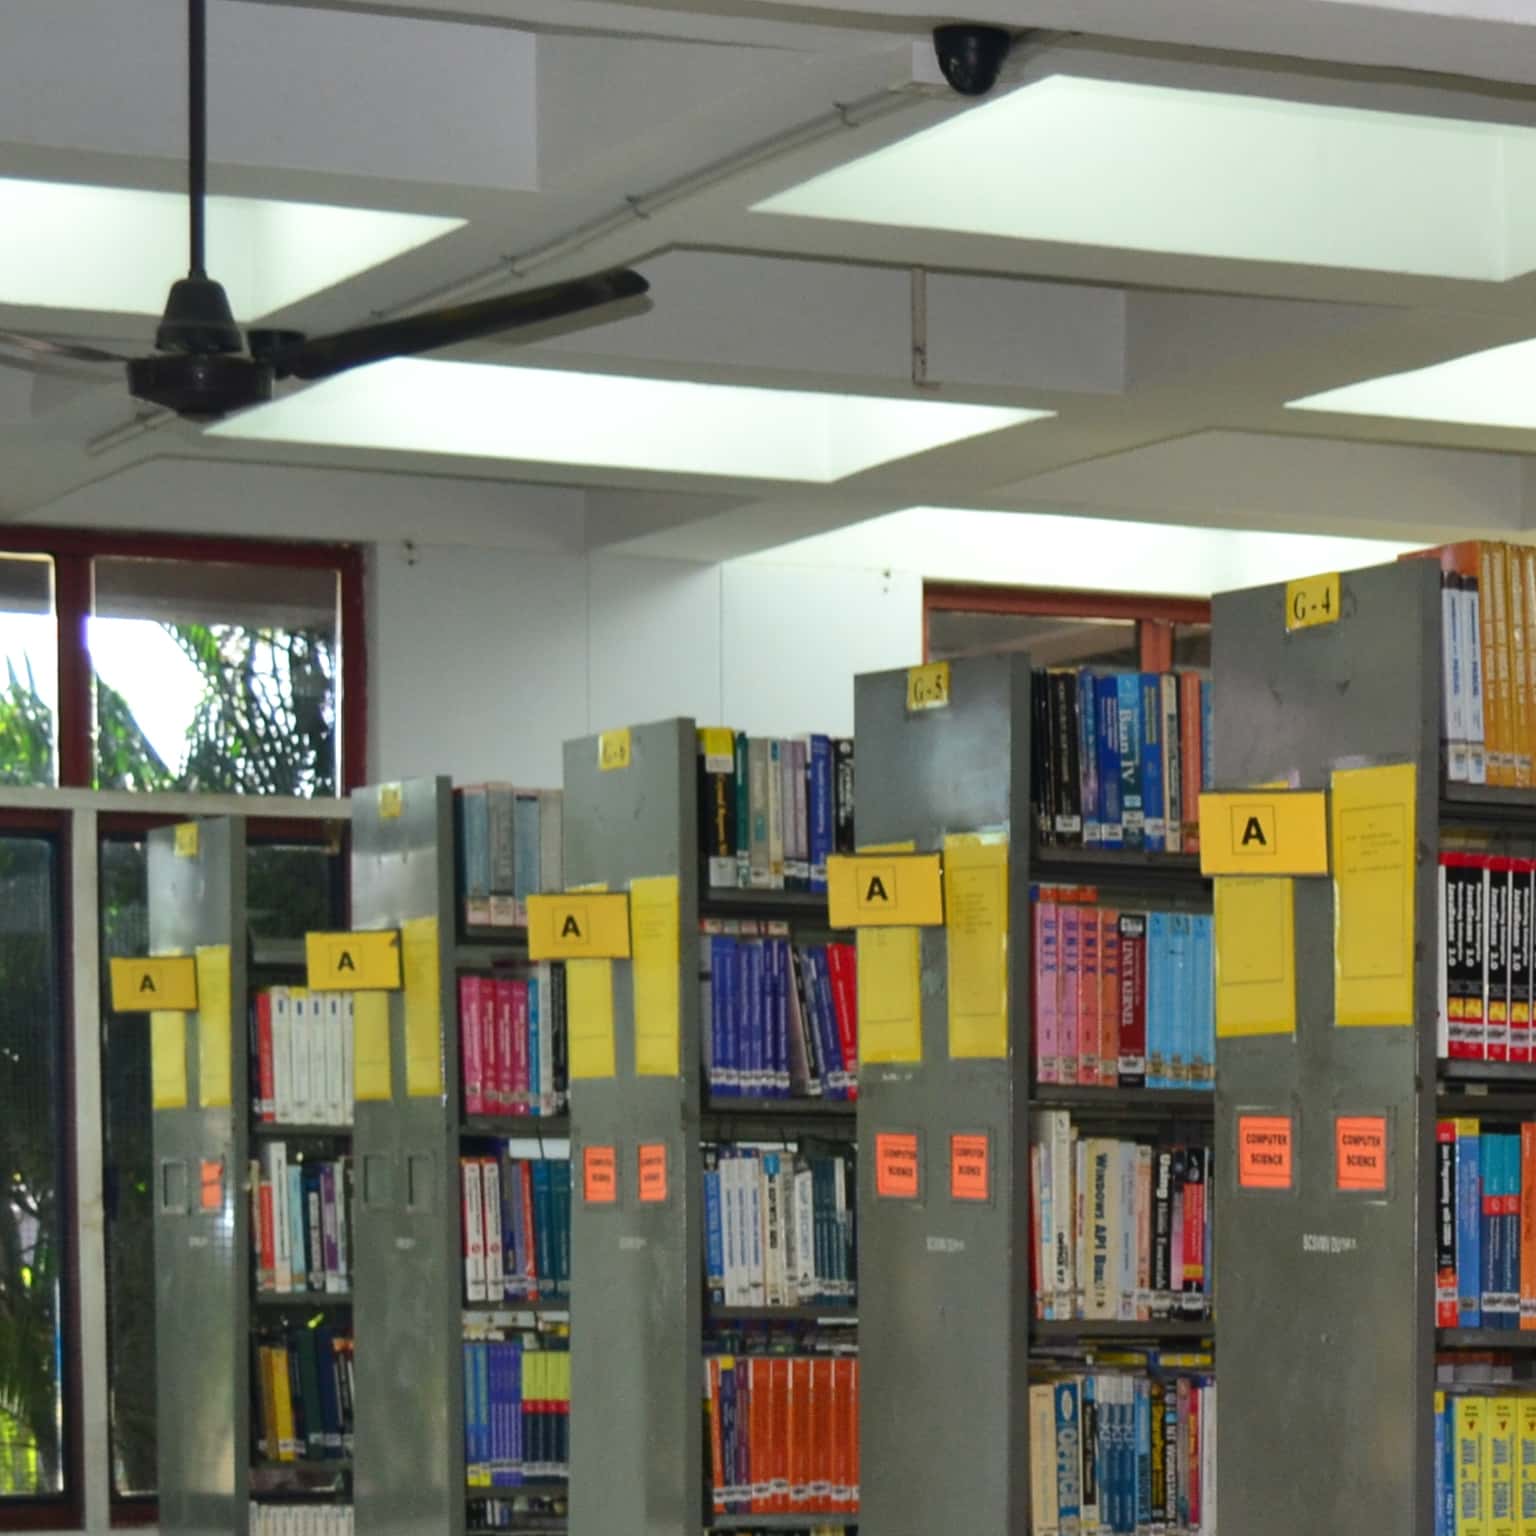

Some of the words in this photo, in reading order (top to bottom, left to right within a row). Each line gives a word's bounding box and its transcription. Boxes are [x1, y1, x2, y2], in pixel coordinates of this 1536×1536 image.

[1241, 817, 1267, 845] A
[866, 878, 889, 900] A
[561, 915, 581, 937] A
[338, 953, 355, 971] A
[140, 975, 155, 992] A
[1246, 1133, 1287, 1144] COMPUTER
[1342, 1135, 1381, 1146] COMPUTER
[1251, 1153, 1283, 1165] SCIENCE
[1347, 1155, 1376, 1168] SCIENCE
